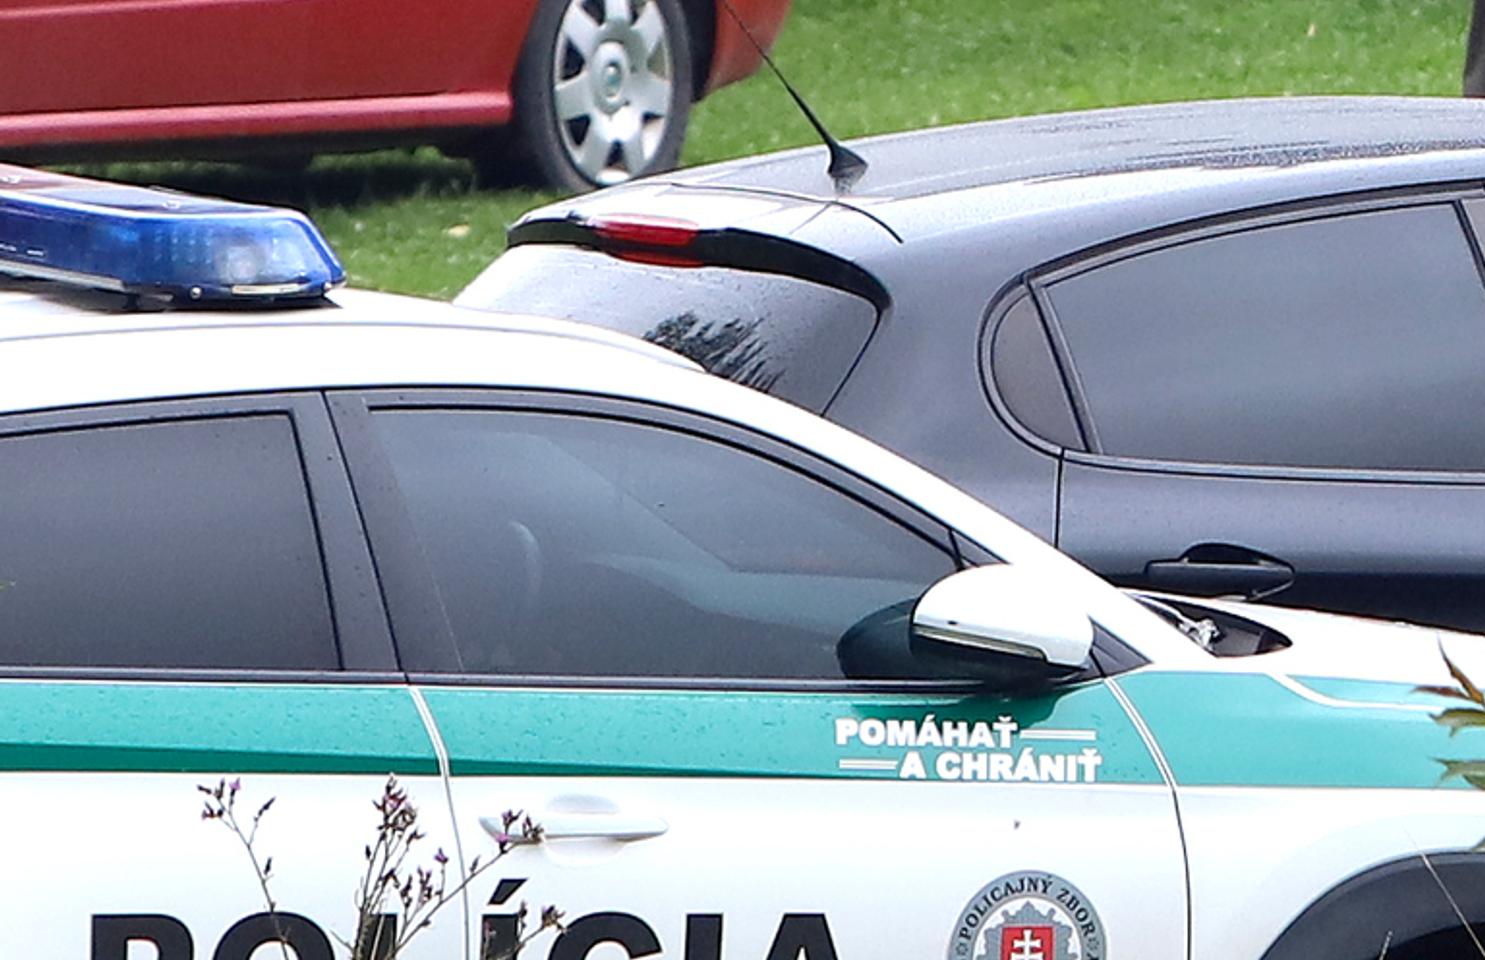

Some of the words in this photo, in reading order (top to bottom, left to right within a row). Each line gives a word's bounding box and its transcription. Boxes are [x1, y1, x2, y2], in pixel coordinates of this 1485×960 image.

[835, 714, 1018, 749] POMÁHAŤ
[899, 750, 927, 779] A
[935, 747, 1102, 783] CHRÁNIŤ
[958, 874, 1053, 941] POLICAJNÝ
[1055, 888, 1097, 938] ZBOR
